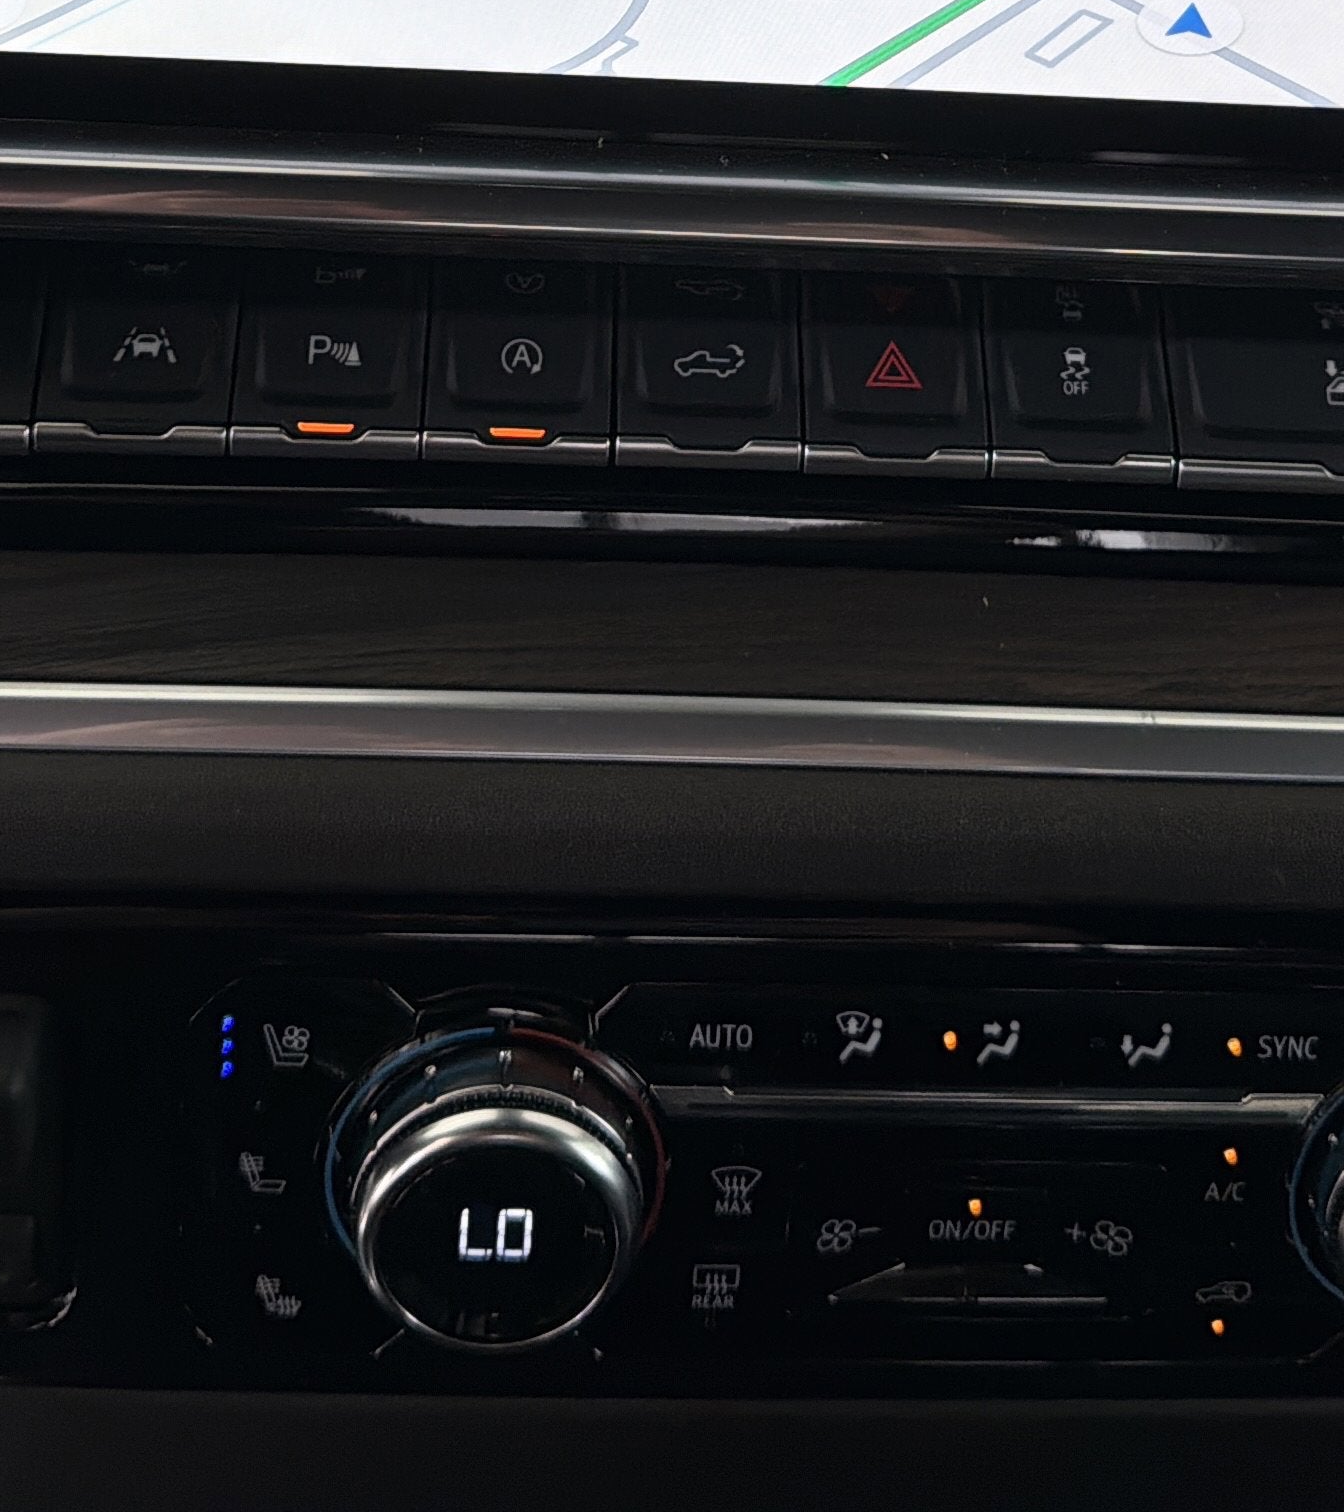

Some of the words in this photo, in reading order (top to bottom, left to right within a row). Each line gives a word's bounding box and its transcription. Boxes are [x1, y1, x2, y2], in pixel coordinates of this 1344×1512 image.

[1063, 380, 1089, 396] OFF
[690, 1024, 753, 1048] AUTO
[1258, 1035, 1318, 1060] SYNC
[1204, 1182, 1246, 1202] A/C
[715, 1200, 752, 1214] MAX
[928, 1220, 1016, 1241] ON/OFF
[692, 1294, 734, 1308] REAR
